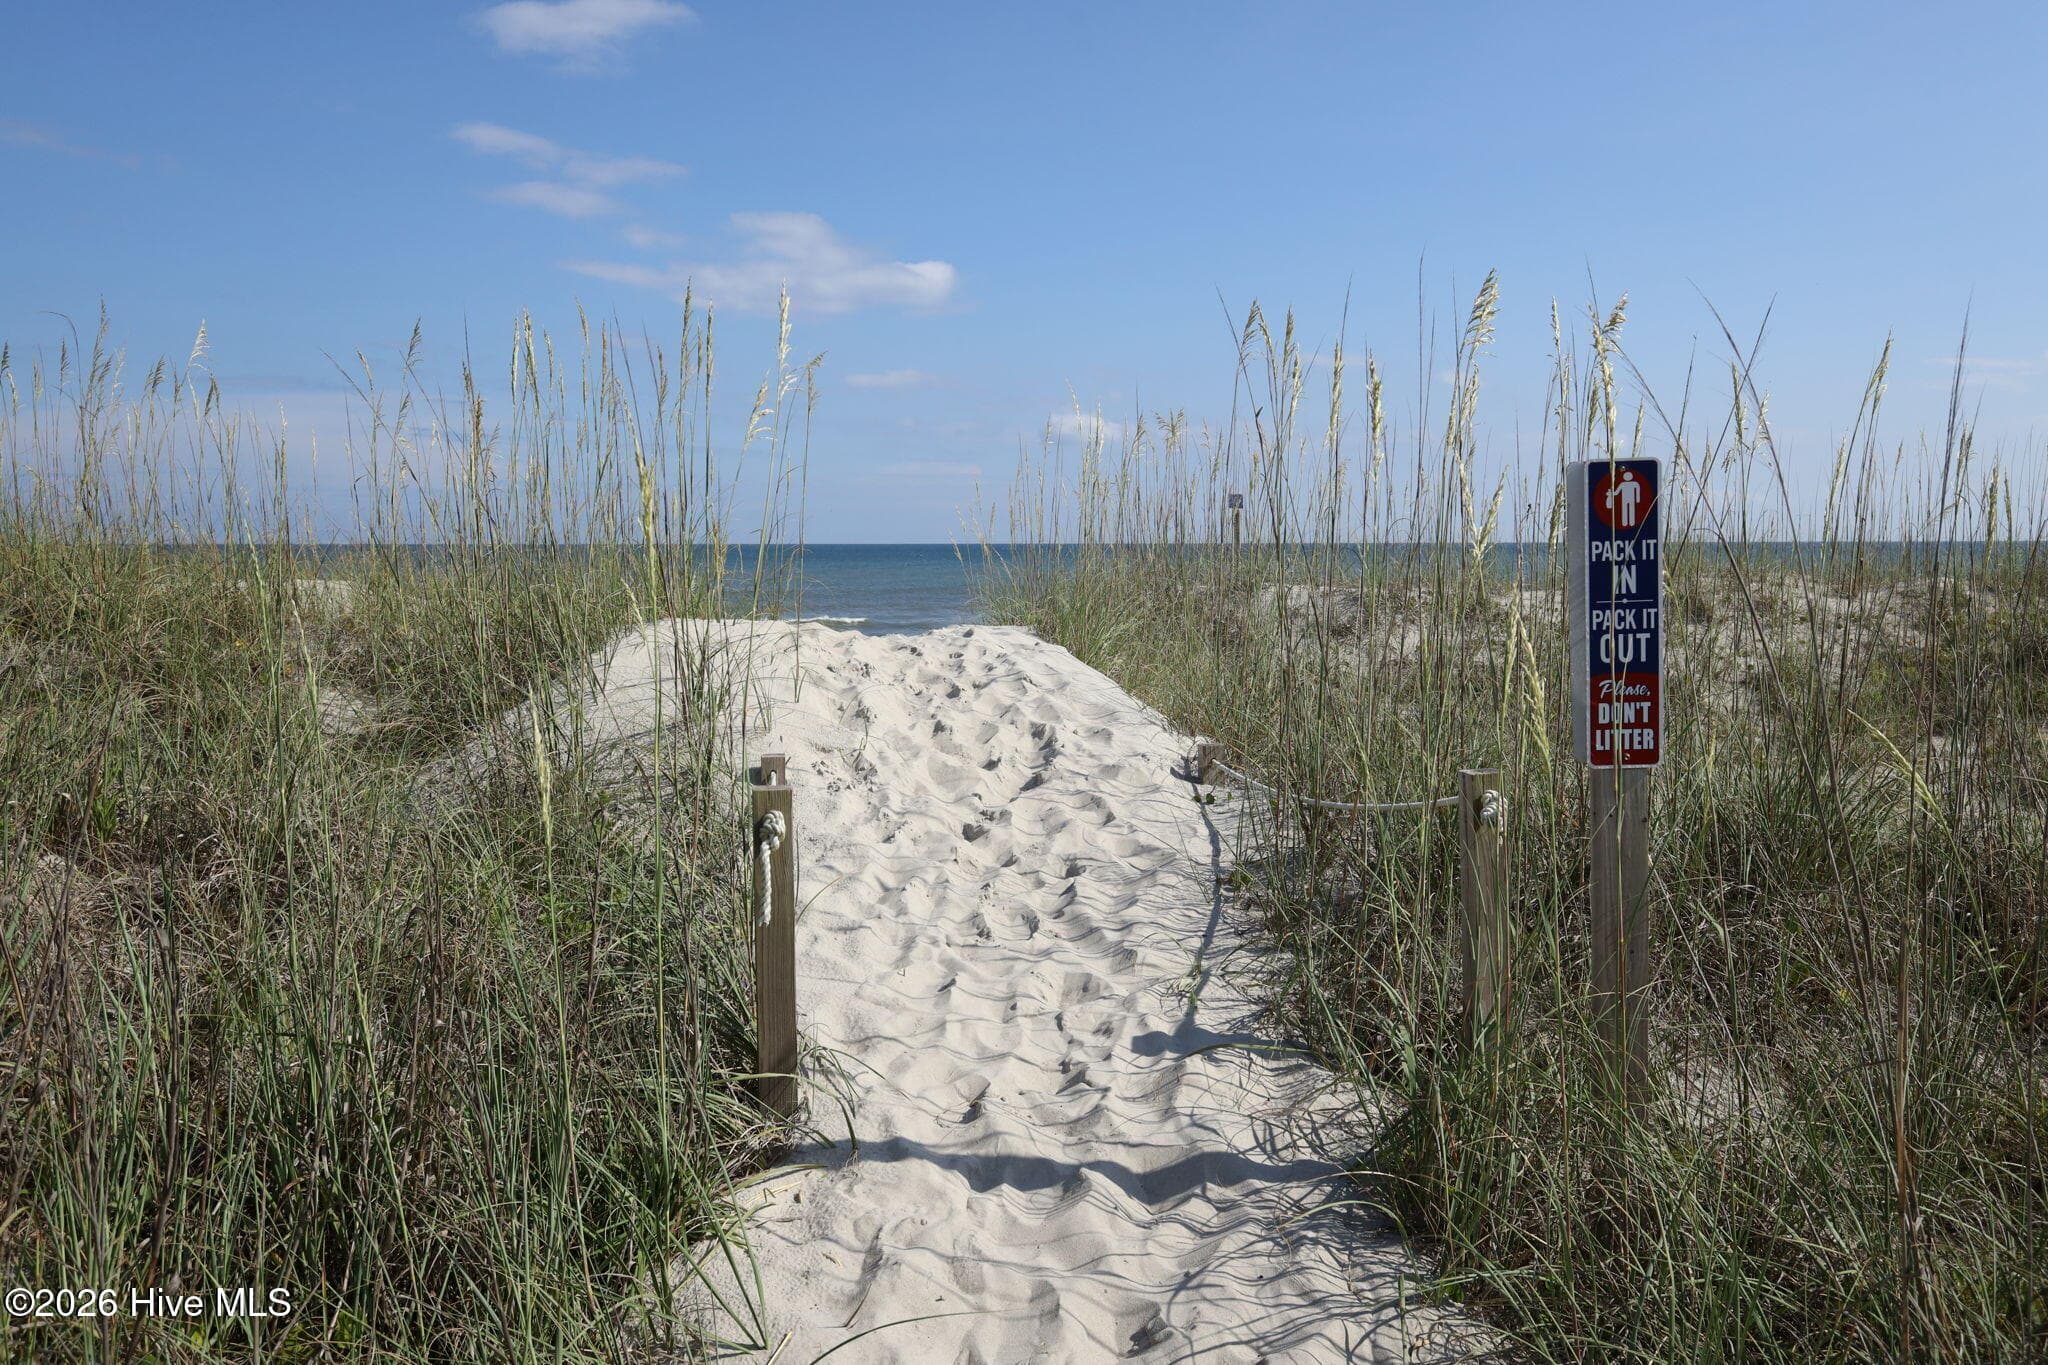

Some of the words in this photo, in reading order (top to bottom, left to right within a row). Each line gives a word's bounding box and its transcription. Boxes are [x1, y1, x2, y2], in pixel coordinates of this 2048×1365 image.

[1591, 540, 1636, 562] PACK
[1642, 539, 1657, 560] IT
[1613, 564, 1637, 595] IN
[1592, 608, 1637, 631] PACK
[1642, 608, 1658, 629] IT
[1600, 632, 1651, 664] OUT
[1598, 680, 1651, 699] Please,
[1598, 701, 1651, 724] DON'T
[1595, 728, 1654, 751] LITTER
